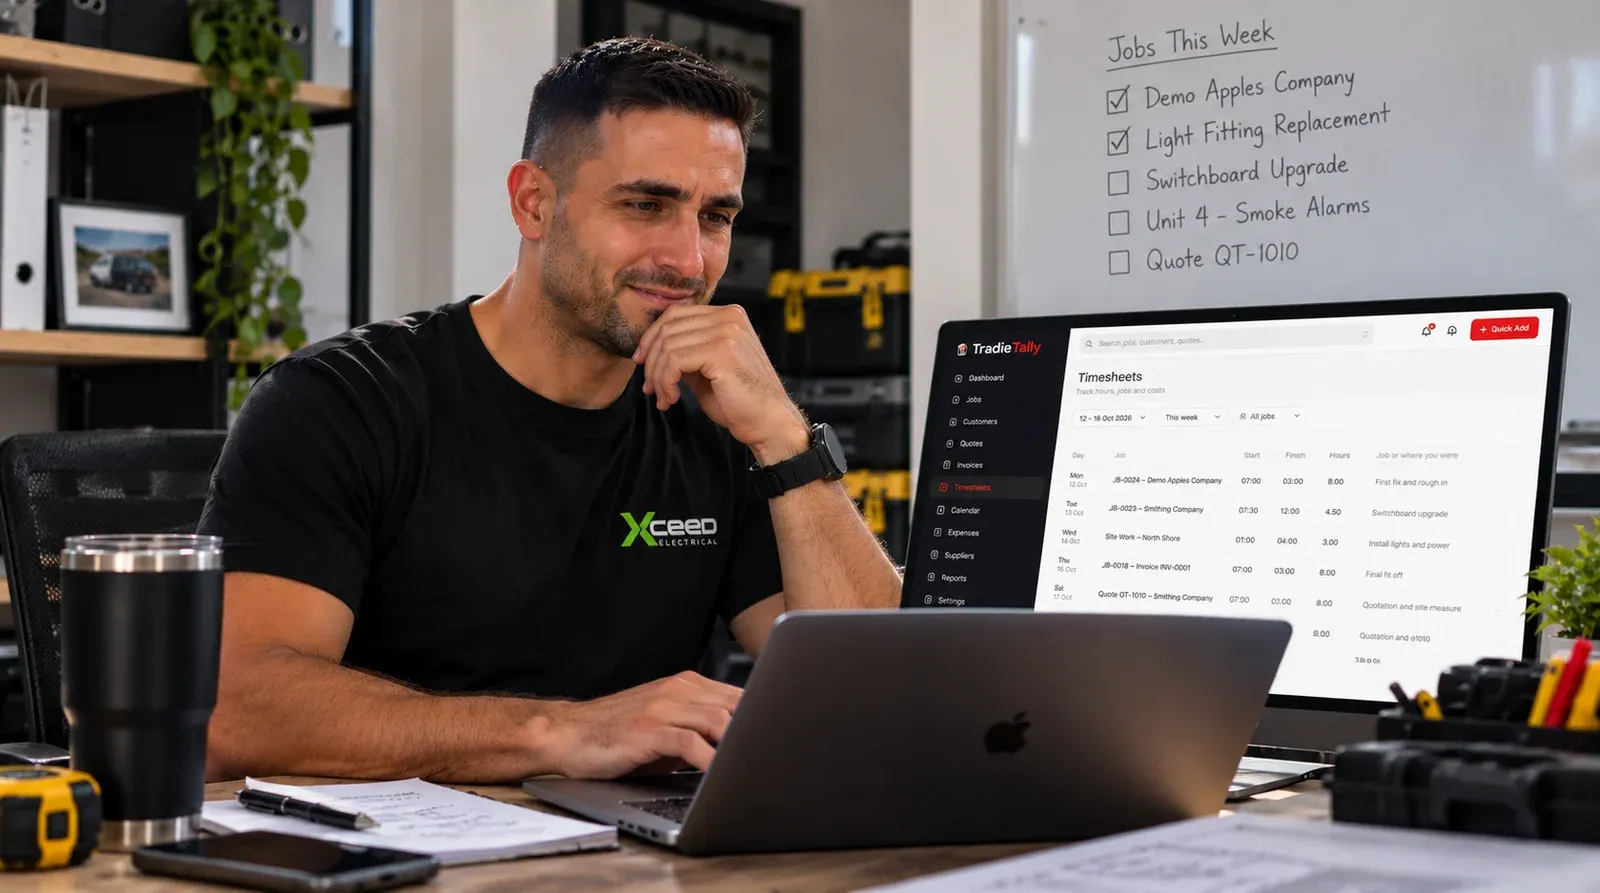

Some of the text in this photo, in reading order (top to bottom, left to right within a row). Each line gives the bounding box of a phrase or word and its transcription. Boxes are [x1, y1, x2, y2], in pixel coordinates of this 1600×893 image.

[1109, 19, 1274, 62] Jobs This Week
[1144, 71, 1354, 108] Demo Apples Company
[1146, 102, 1390, 157] Light Fitting Replacement
[1147, 154, 1348, 190] Switchboard Upgrade
[1148, 209, 1185, 231] Unit
[1196, 205, 1208, 227] 4
[1236, 200, 1296, 223] Smoke
[1307, 196, 1370, 217] Alarms
[1147, 242, 1298, 271] Quote QT-1010
[1491, 325, 1512, 333] Quick
[969, 374, 1004, 382] Dashboard
[1078, 372, 1142, 383] Timesheets
[1095, 388, 1115, 396] hours,
[1261, 413, 1275, 421] jobs
[1072, 452, 1085, 460] Day
[1191, 477, 1222, 485] Company
[1144, 506, 1171, 514] Smithing
[1173, 506, 1204, 514] Company
[1372, 509, 1416, 517] Switchboard
[948, 528, 979, 537] Expenses
[1369, 540, 1389, 548] Install
[1391, 541, 1410, 549] lights
[1427, 542, 1450, 550] power
[945, 552, 974, 560] Suppliers
[942, 574, 967, 582] Reports
[1154, 593, 1180, 601] Smithing
[1182, 594, 1213, 602] Company
[1363, 601, 1398, 610] Quotation
[1360, 632, 1394, 640] Quotation
